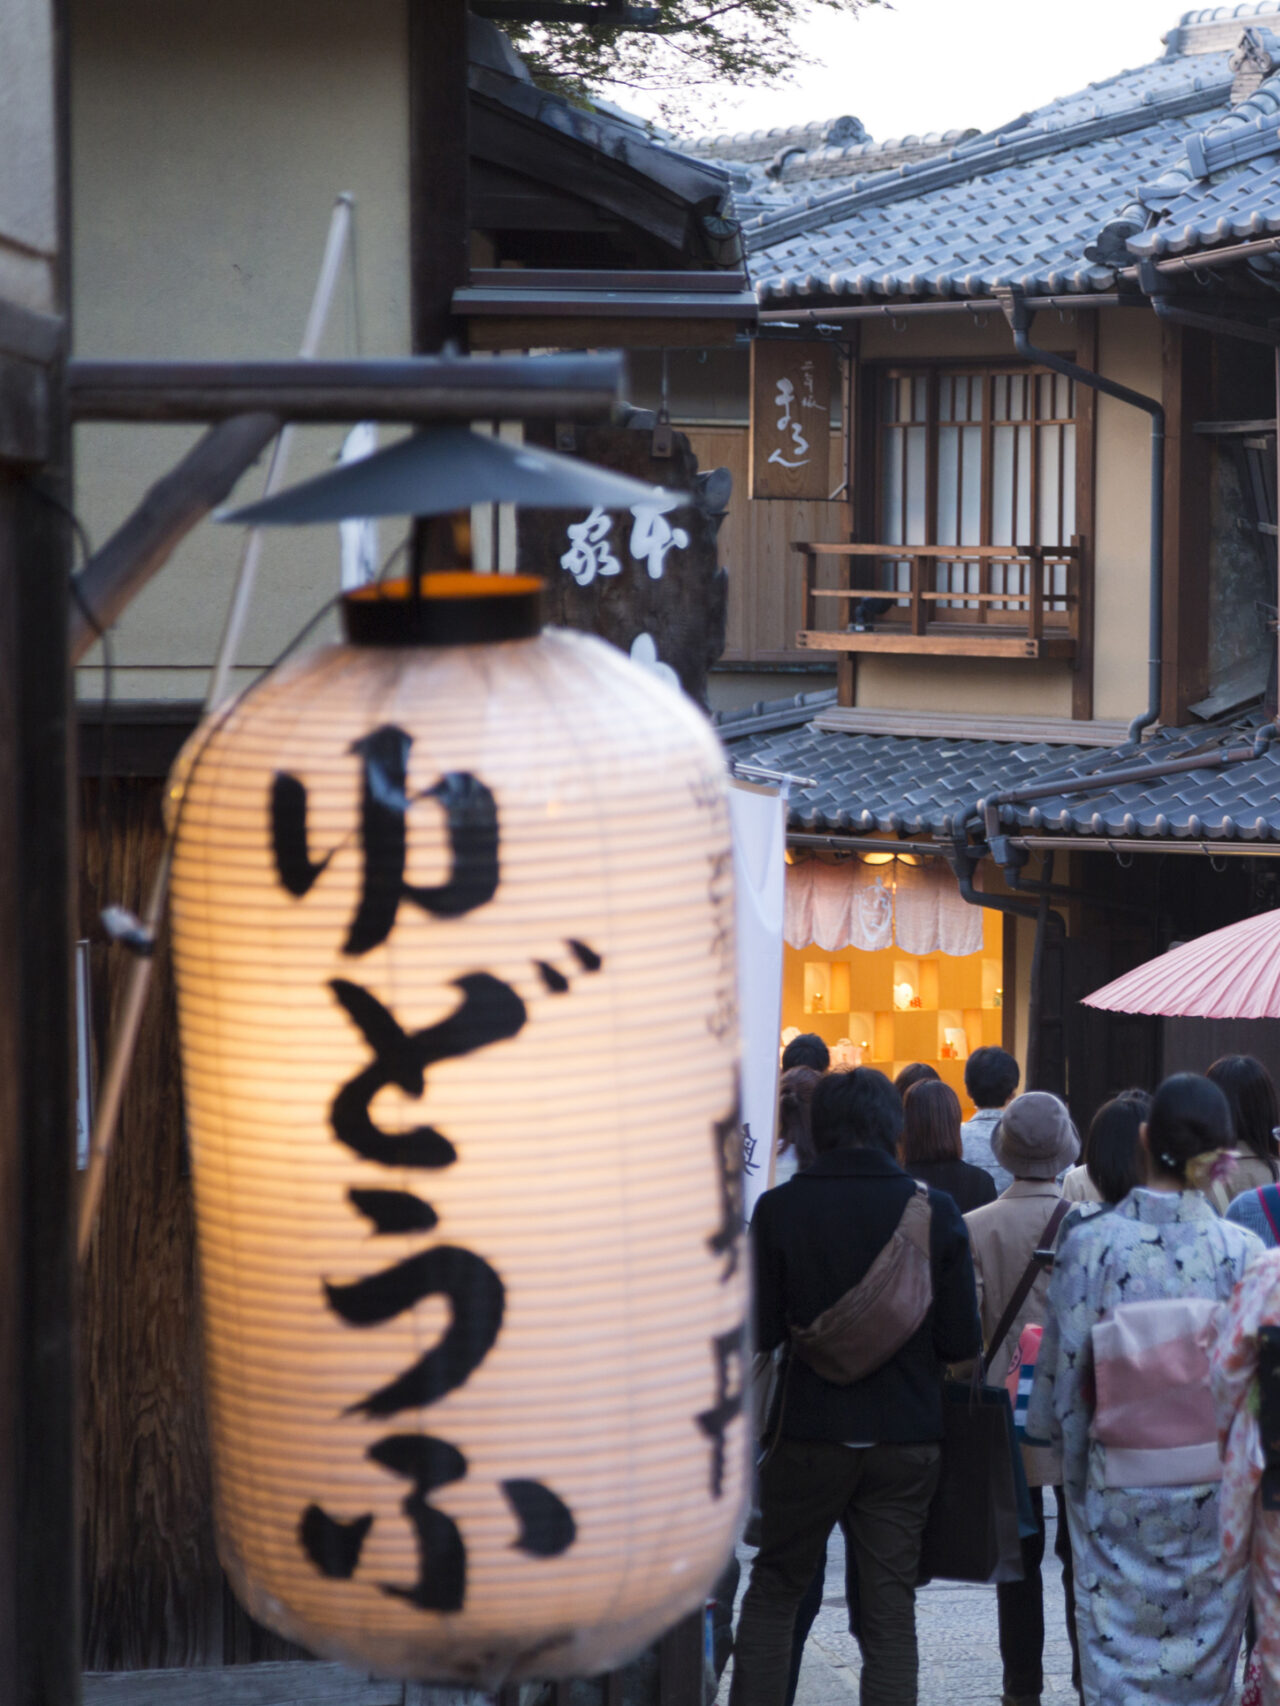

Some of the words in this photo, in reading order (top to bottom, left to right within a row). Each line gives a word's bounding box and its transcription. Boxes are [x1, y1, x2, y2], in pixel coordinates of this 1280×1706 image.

[767, 376, 812, 468] まるん
[267, 723, 603, 1614] ゆどうふ
